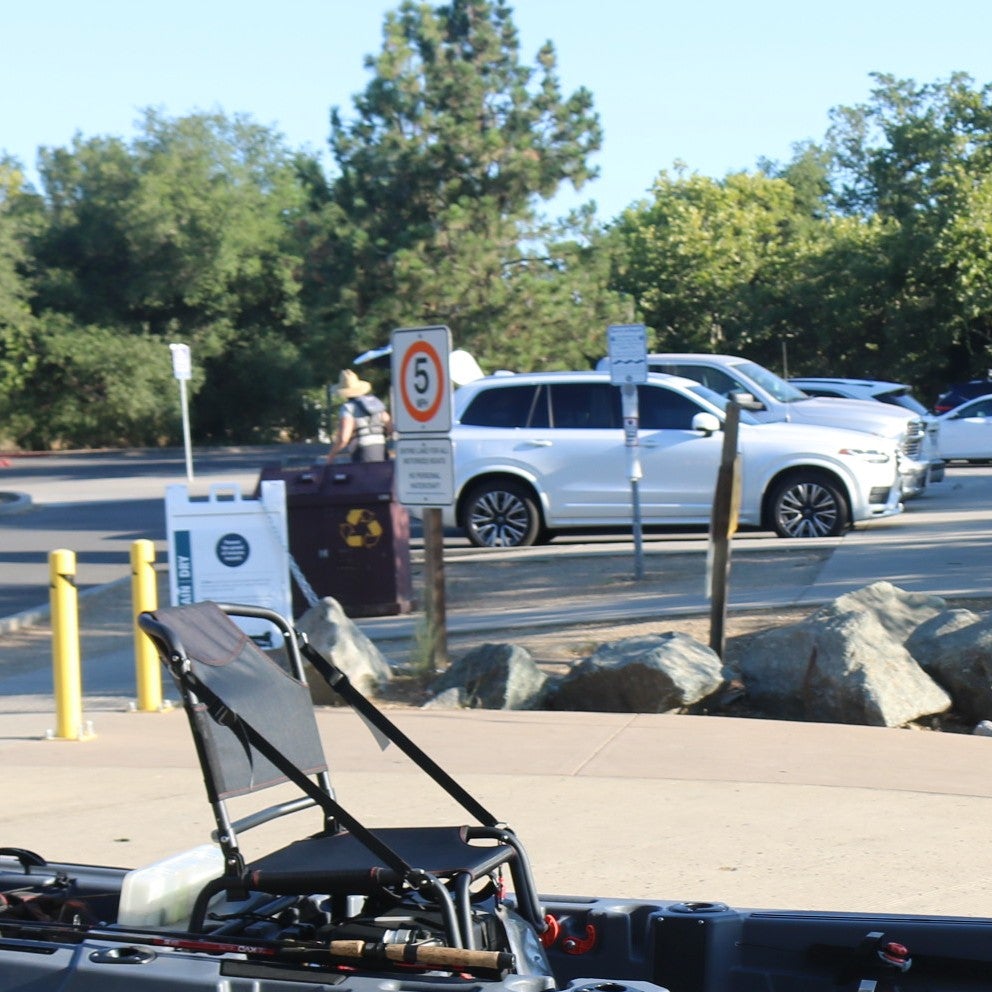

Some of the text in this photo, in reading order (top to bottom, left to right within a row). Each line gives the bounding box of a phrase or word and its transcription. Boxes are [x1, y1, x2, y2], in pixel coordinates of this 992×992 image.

[414, 357, 429, 394] 5
[178, 555, 192, 604] AIN DRY
